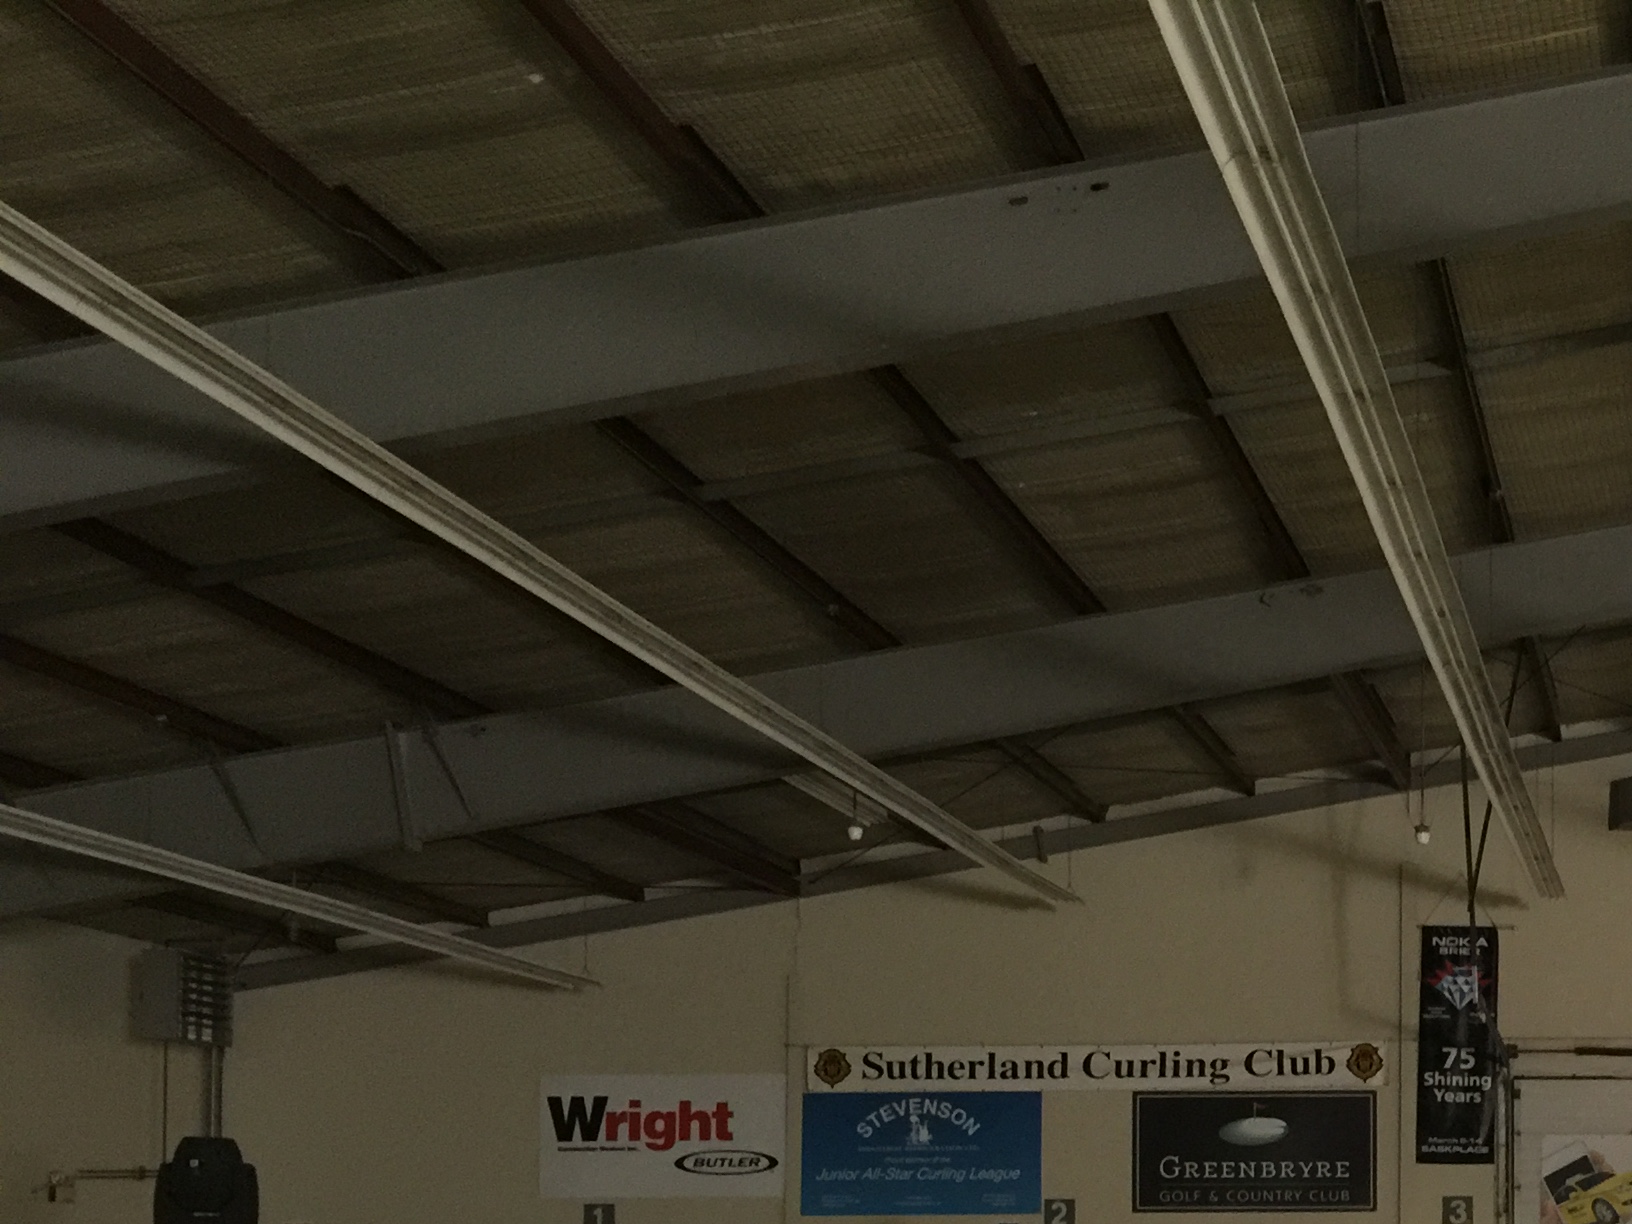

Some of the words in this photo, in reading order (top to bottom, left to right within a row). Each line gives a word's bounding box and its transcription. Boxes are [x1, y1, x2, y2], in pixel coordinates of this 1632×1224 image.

[1432, 936, 1488, 948] NOKA
[861, 1051, 1068, 1081] Sutherland
[1082, 1050, 1230, 1085] Curling
[1244, 1048, 1336, 1077] Club
[1442, 1047, 1475, 1069] 75
[1423, 1072, 1492, 1090] Shining
[1433, 1088, 1482, 1103] Years
[547, 1096, 734, 1151] Wright
[857, 1098, 981, 1138] STEVENSON
[692, 1157, 762, 1169] BUTLER
[1159, 1156, 1350, 1179] GREENBRYRE
[815, 1168, 859, 1181] Junior
[862, 1168, 913, 1181] All-Star
[917, 1167, 964, 1183] Curling
[969, 1167, 1021, 1183] League
[1160, 1190, 1201, 1202] GOLF
[1209, 1190, 1218, 1202] &
[1226, 1190, 1302, 1202] COUNTRY
[1309, 1190, 1350, 1202] CLUB
[1449, 1200, 1467, 1224] 3
